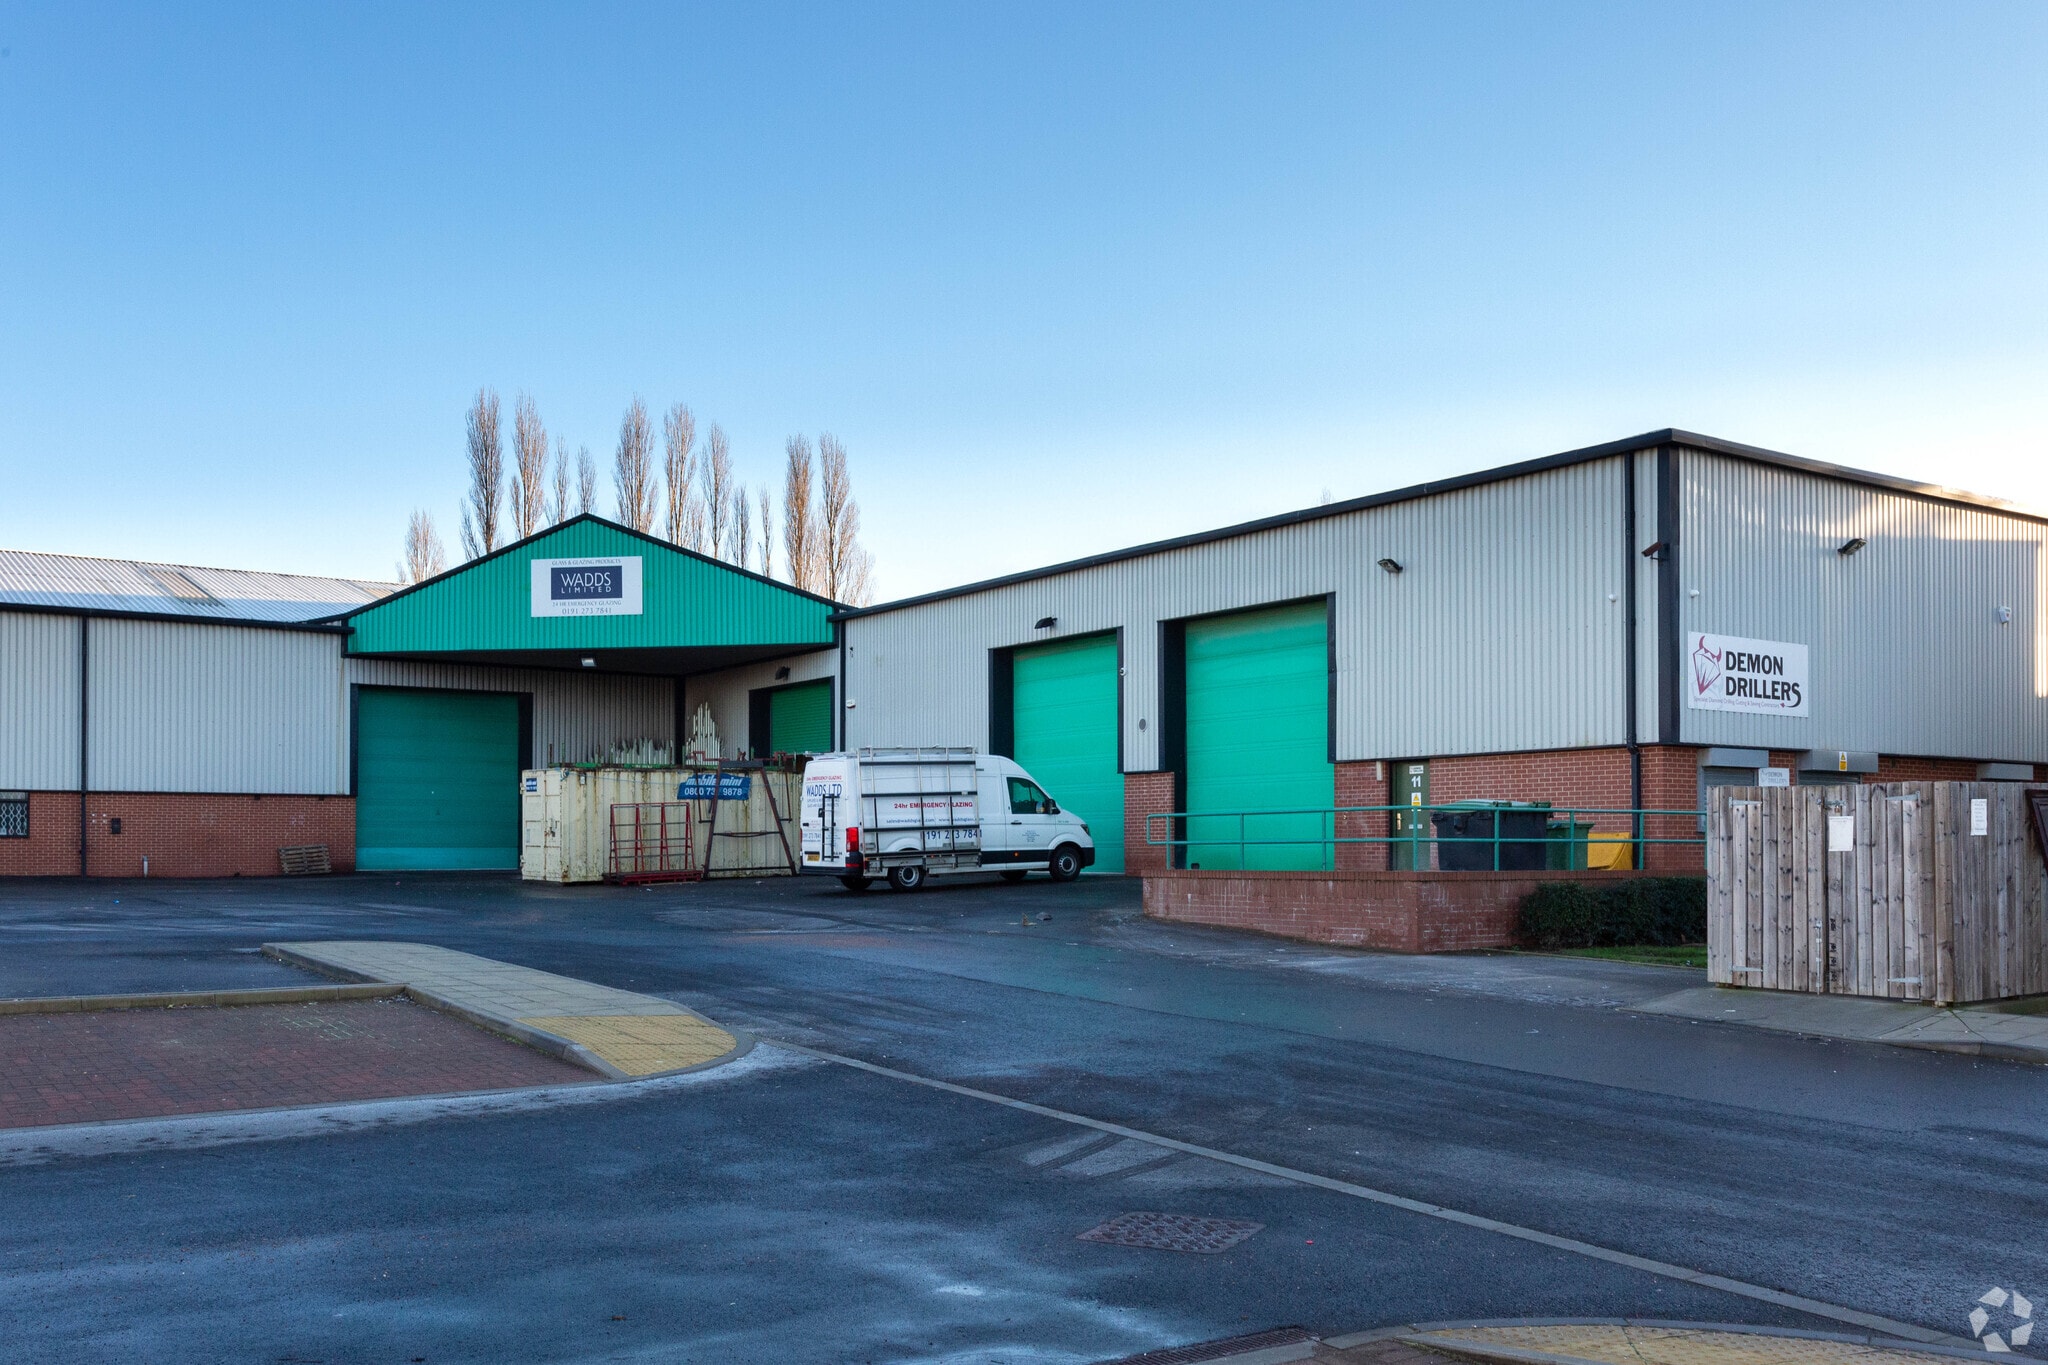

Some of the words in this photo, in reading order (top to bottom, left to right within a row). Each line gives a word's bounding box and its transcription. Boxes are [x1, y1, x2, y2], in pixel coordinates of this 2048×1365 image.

[561, 572, 611, 587] WADDS
[1726, 651, 1783, 676] DEMON
[1726, 676, 1801, 707] DRILLERS
[720, 777, 743, 786] mini
[1411, 776, 1421, 788] 11
[706, 788, 719, 796] 73
[723, 788, 742, 796] 9878
[806, 784, 826, 797] WADDS
[828, 783, 842, 796] LTD
[944, 830, 960, 839] 23
